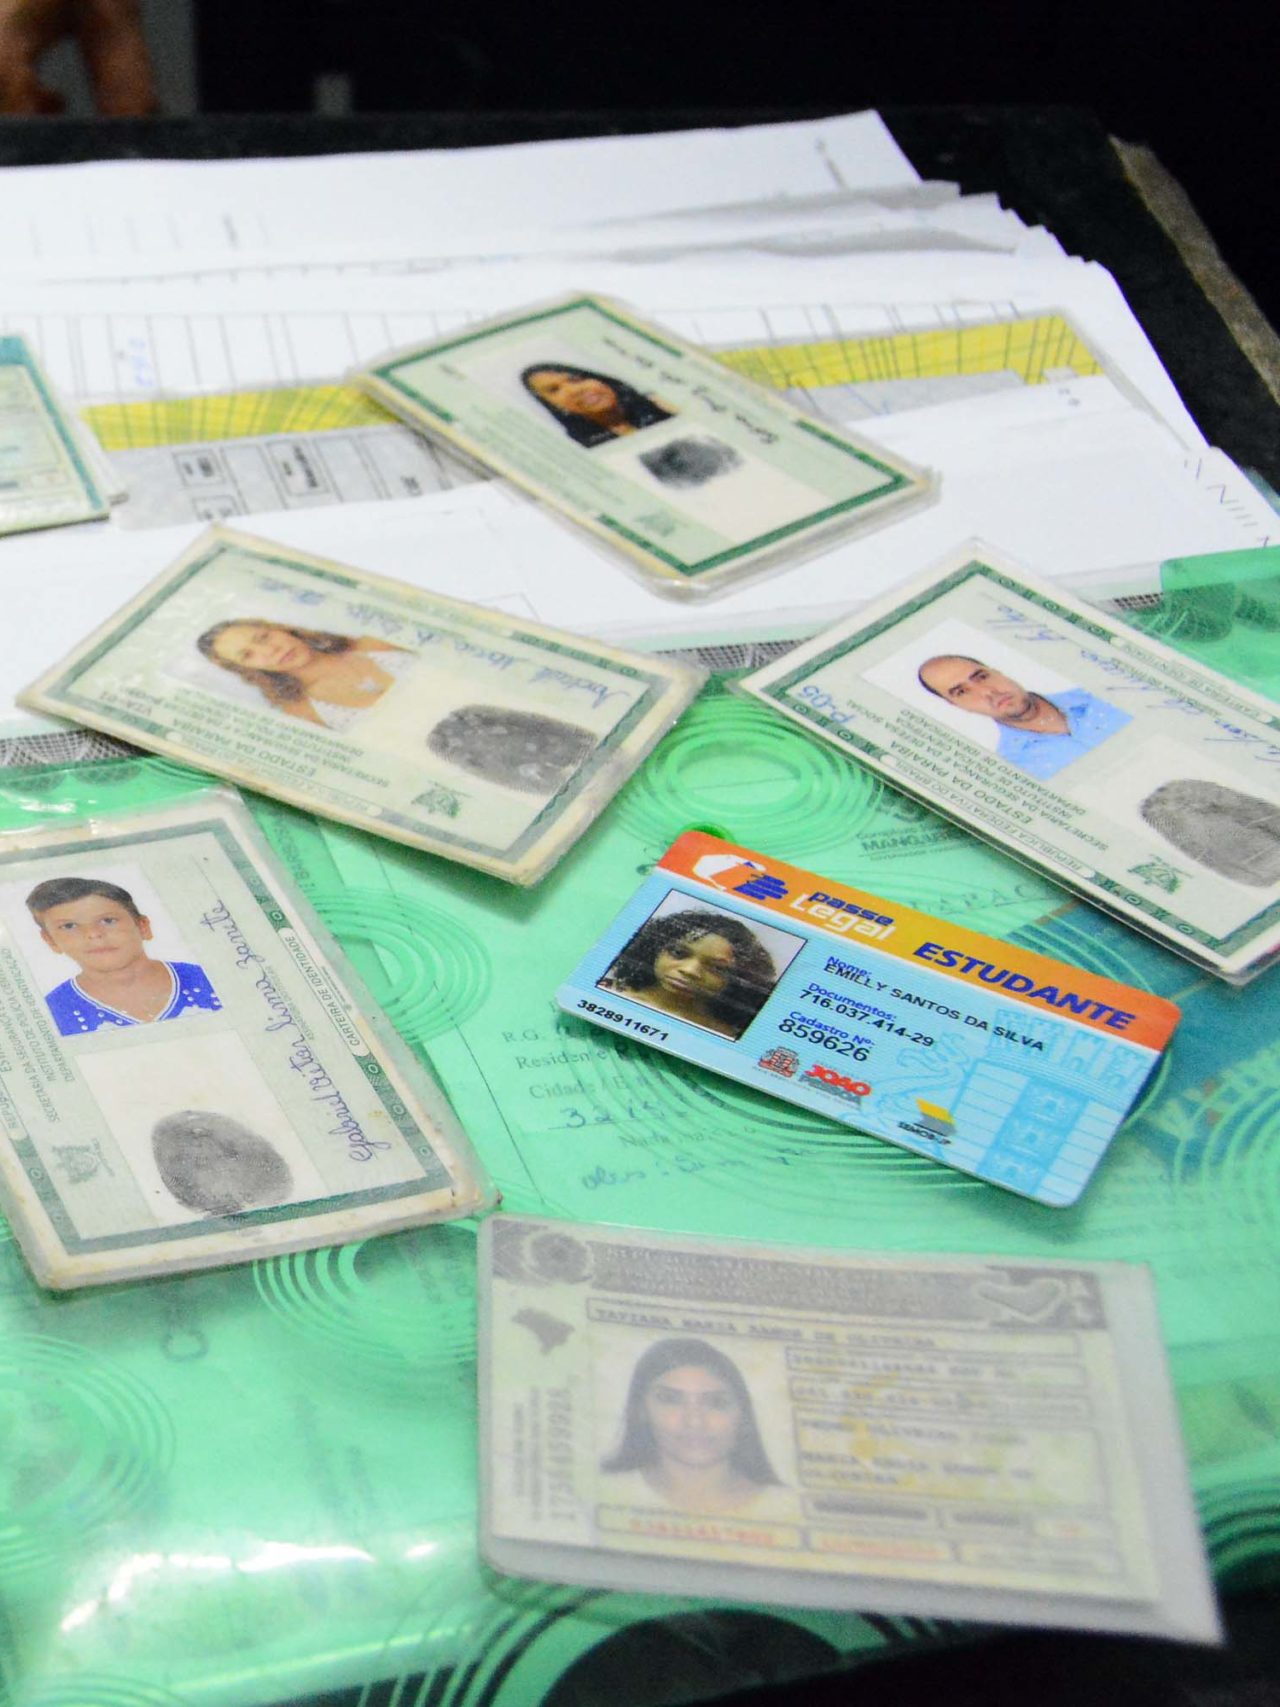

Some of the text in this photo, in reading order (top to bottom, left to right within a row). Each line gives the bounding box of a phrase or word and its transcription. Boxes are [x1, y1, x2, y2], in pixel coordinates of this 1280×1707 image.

[255, 749, 318, 776] ESTADO
[949, 774, 973, 791] DA
[971, 788, 1034, 824] ESTADO
[1010, 783, 1074, 820] INSTITUTO
[1018, 799, 1039, 812] DA
[1037, 809, 1110, 851] SECRETARIA
[785, 891, 896, 947] Legal
[808, 890, 895, 928] passe
[282, 934, 325, 986] IDENTIDADE
[315, 987, 333, 1001] DE
[806, 982, 897, 1021] Documentos:
[912, 939, 1135, 1032] ESTUDANTE
[322, 1001, 361, 1046] CARTEIRA
[575, 998, 669, 1042] 3828911671
[788, 1010, 850, 1039] Cadastro
[798, 989, 935, 1047] 716.037.414-29
[822, 963, 1046, 1052] EMILLY SANTOS DA SILVA
[28, 1039, 59, 1081] INSTITUTO
[776, 1017, 871, 1063] 859626
[20, 1060, 37, 1073] DA
[26, 1072, 61, 1122] SECRETARIA
